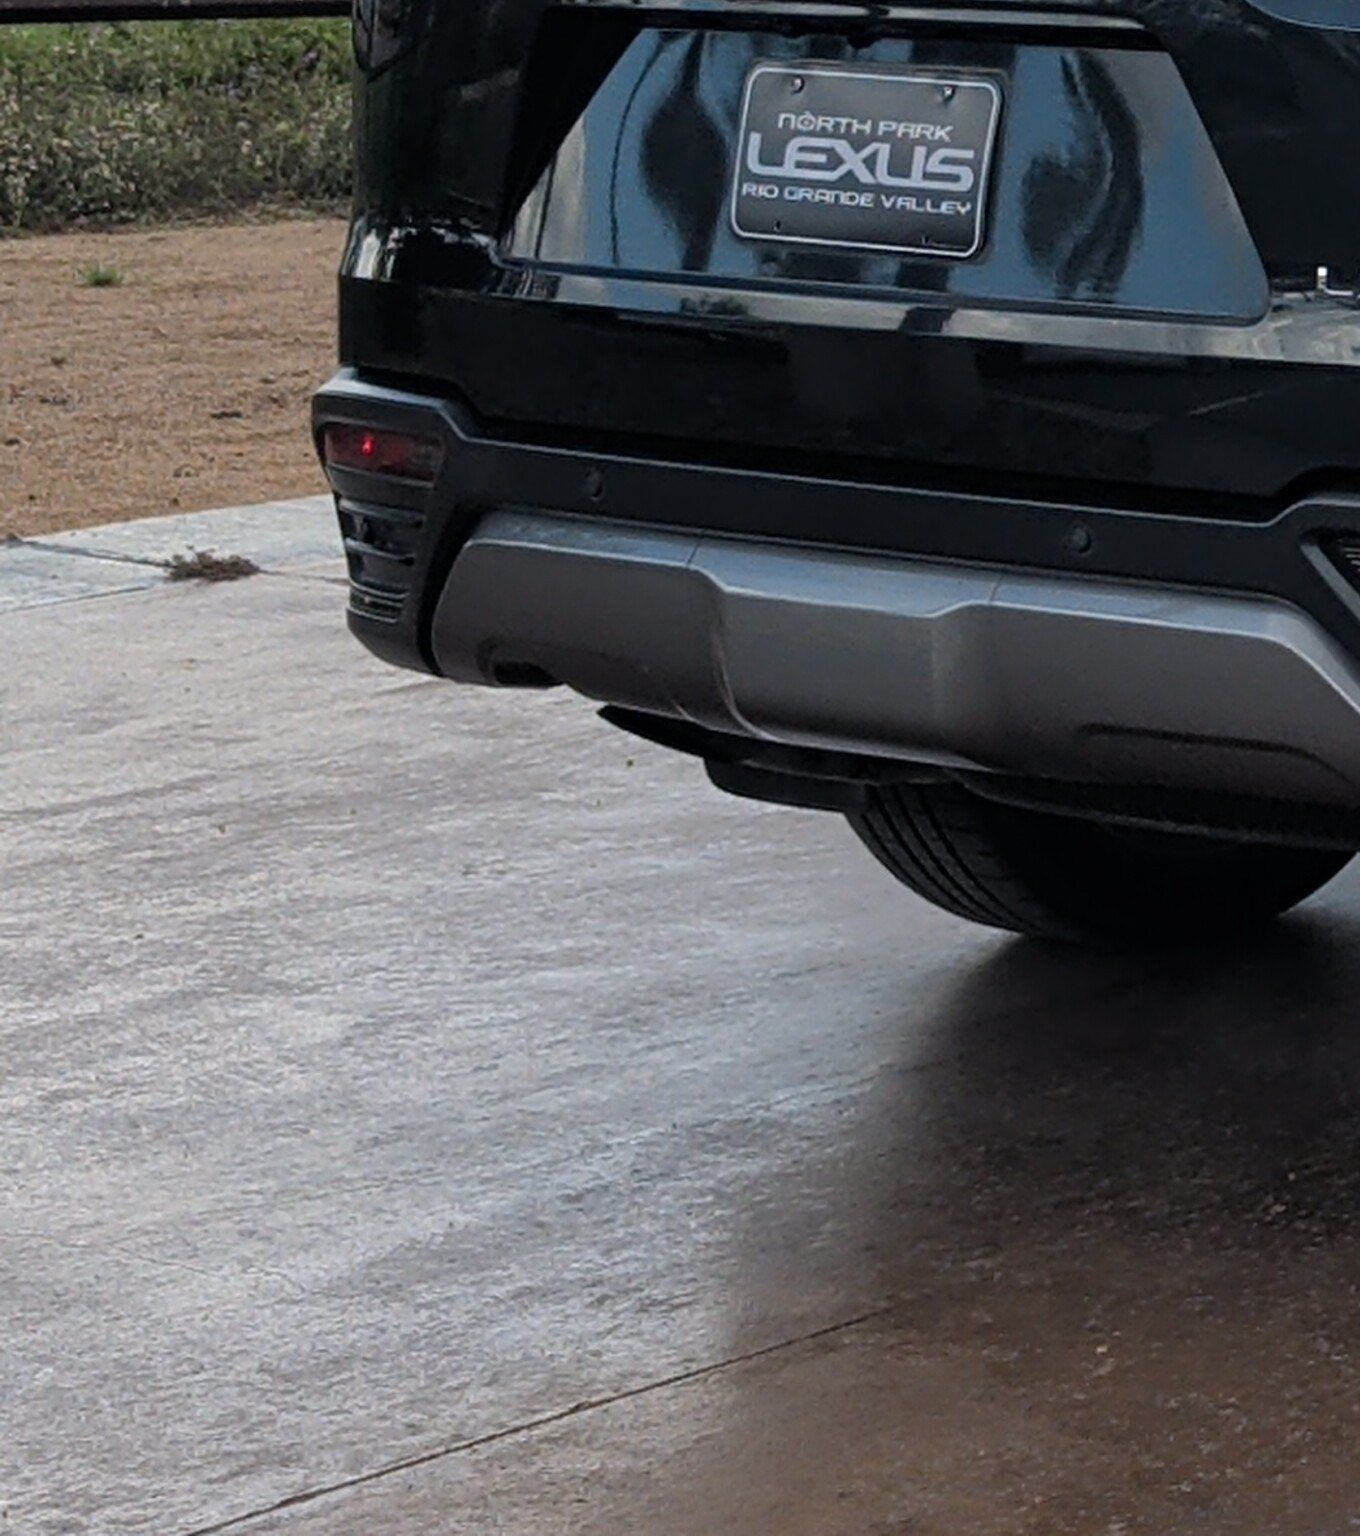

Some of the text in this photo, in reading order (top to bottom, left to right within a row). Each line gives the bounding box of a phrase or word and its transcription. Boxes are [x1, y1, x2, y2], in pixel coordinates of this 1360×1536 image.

[777, 111, 955, 142] NORTH PARK
[746, 131, 975, 192] LEXUS
[742, 182, 972, 216] RIO GRANDE VALLEY
